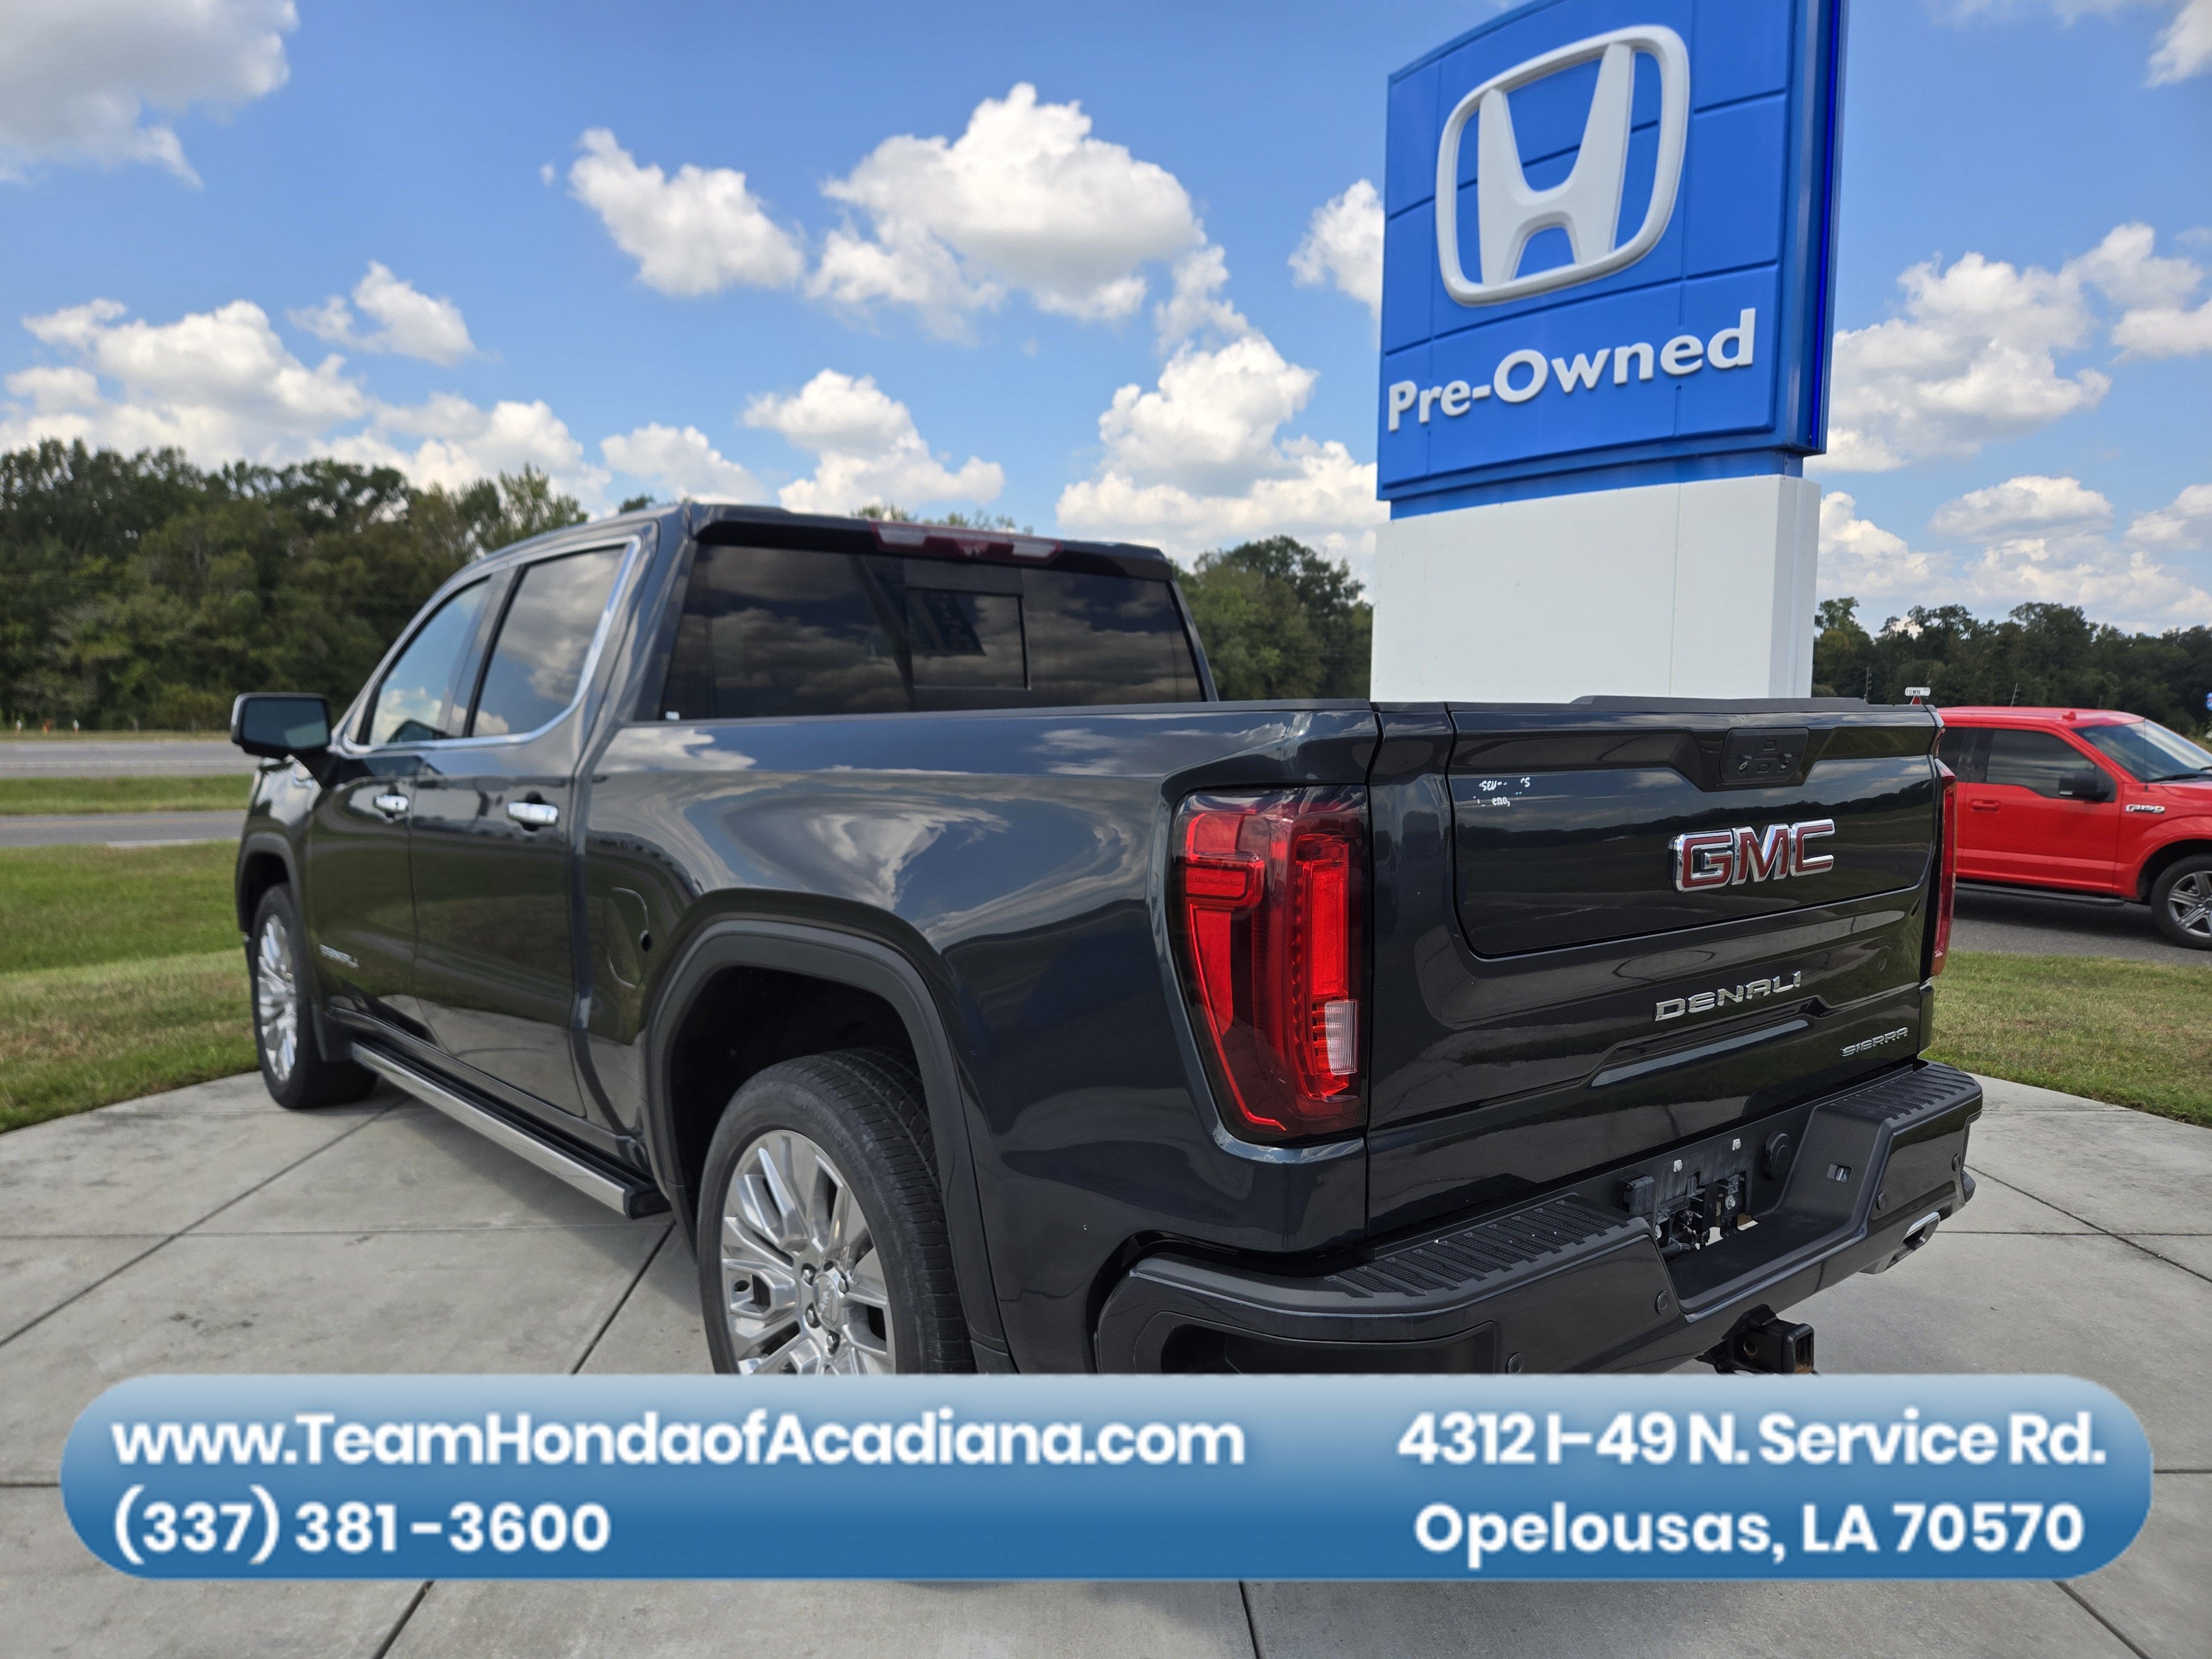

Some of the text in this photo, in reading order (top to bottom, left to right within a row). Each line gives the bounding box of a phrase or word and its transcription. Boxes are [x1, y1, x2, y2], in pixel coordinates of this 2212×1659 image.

[1387, 307, 1756, 431] Pre-Owned
[1669, 818, 1835, 893] GMC
[1654, 971, 1802, 1021] DENALI
[1840, 1027, 1908, 1057] SIERRA
